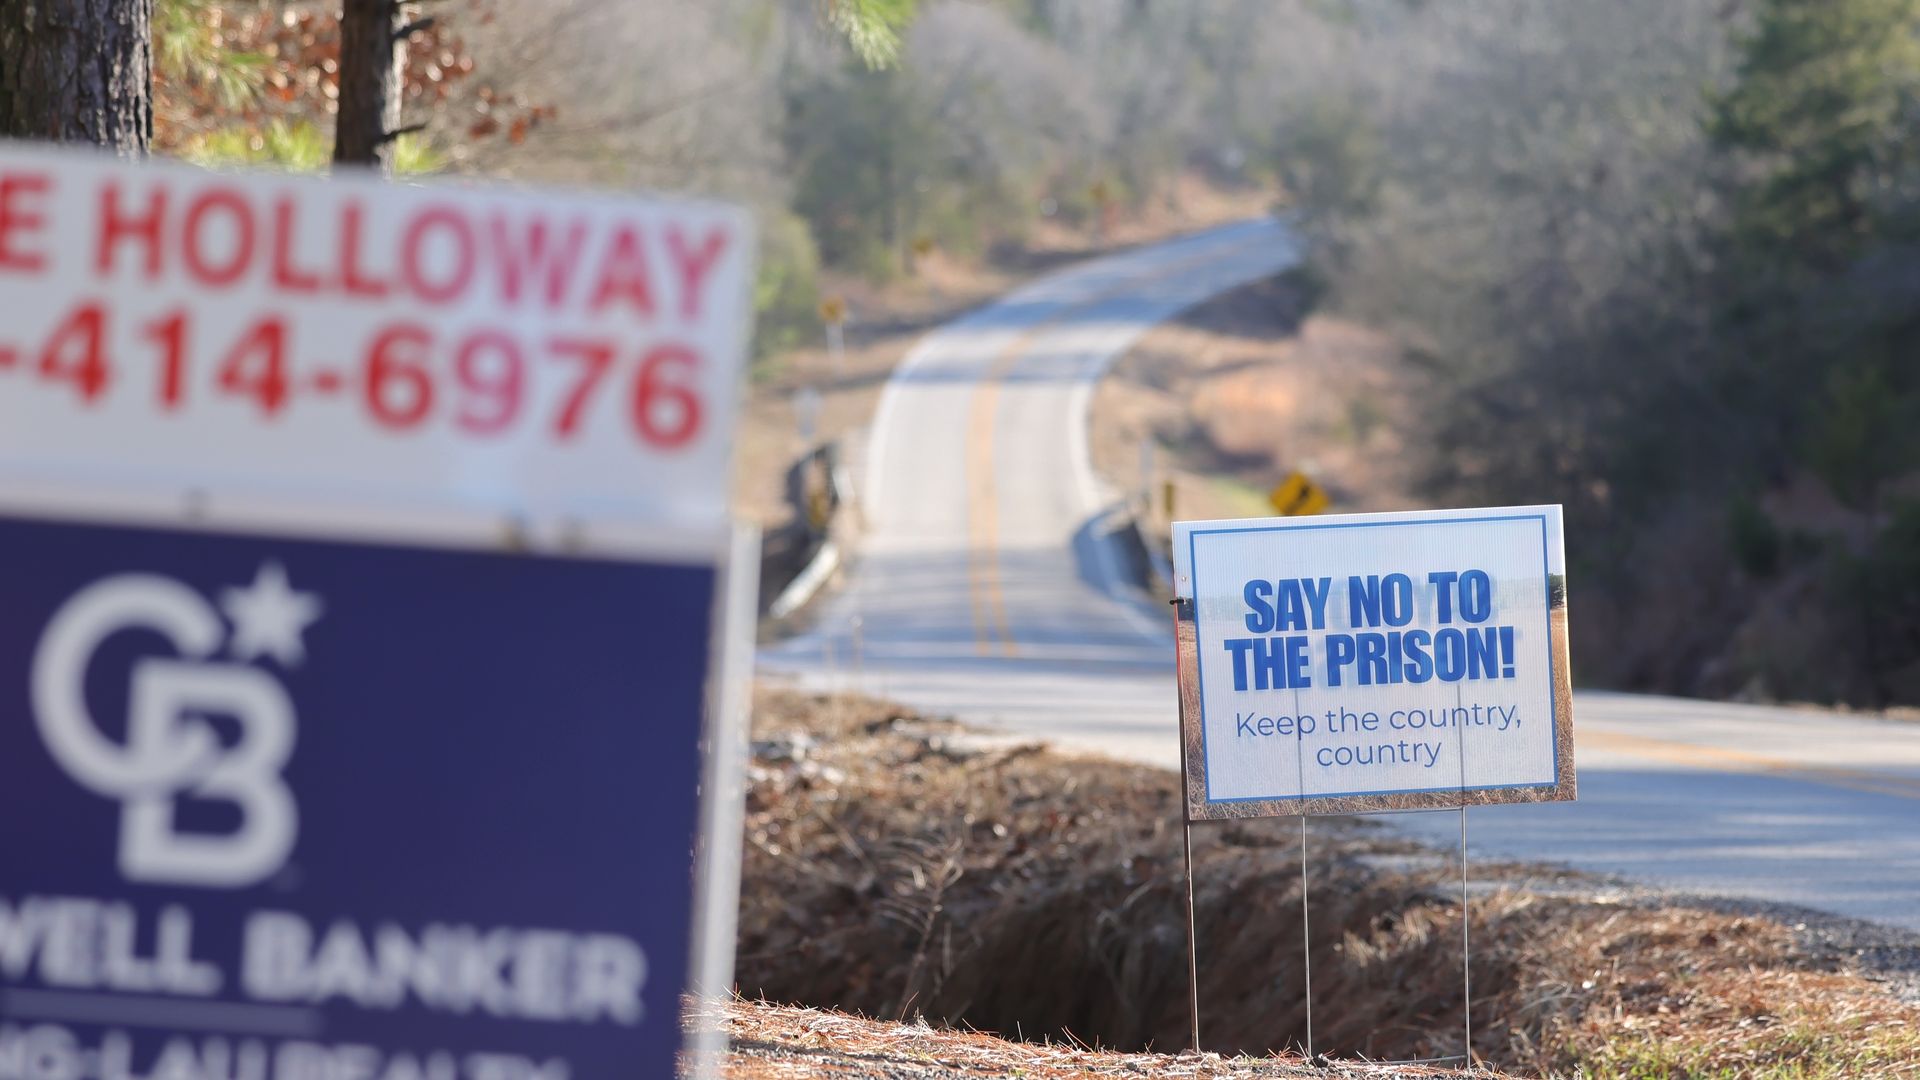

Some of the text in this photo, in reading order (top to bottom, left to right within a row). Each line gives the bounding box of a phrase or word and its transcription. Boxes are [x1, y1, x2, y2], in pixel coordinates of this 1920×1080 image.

[93, 182, 731, 319] HOLLOWAY
[1243, 569, 1492, 634] SAY NO TO
[1224, 626, 1516, 692] THE PRISON!
[1235, 703, 1522, 740] Keep the country,
[1316, 740, 1442, 768] country
[243, 912, 647, 1025] BANKER
